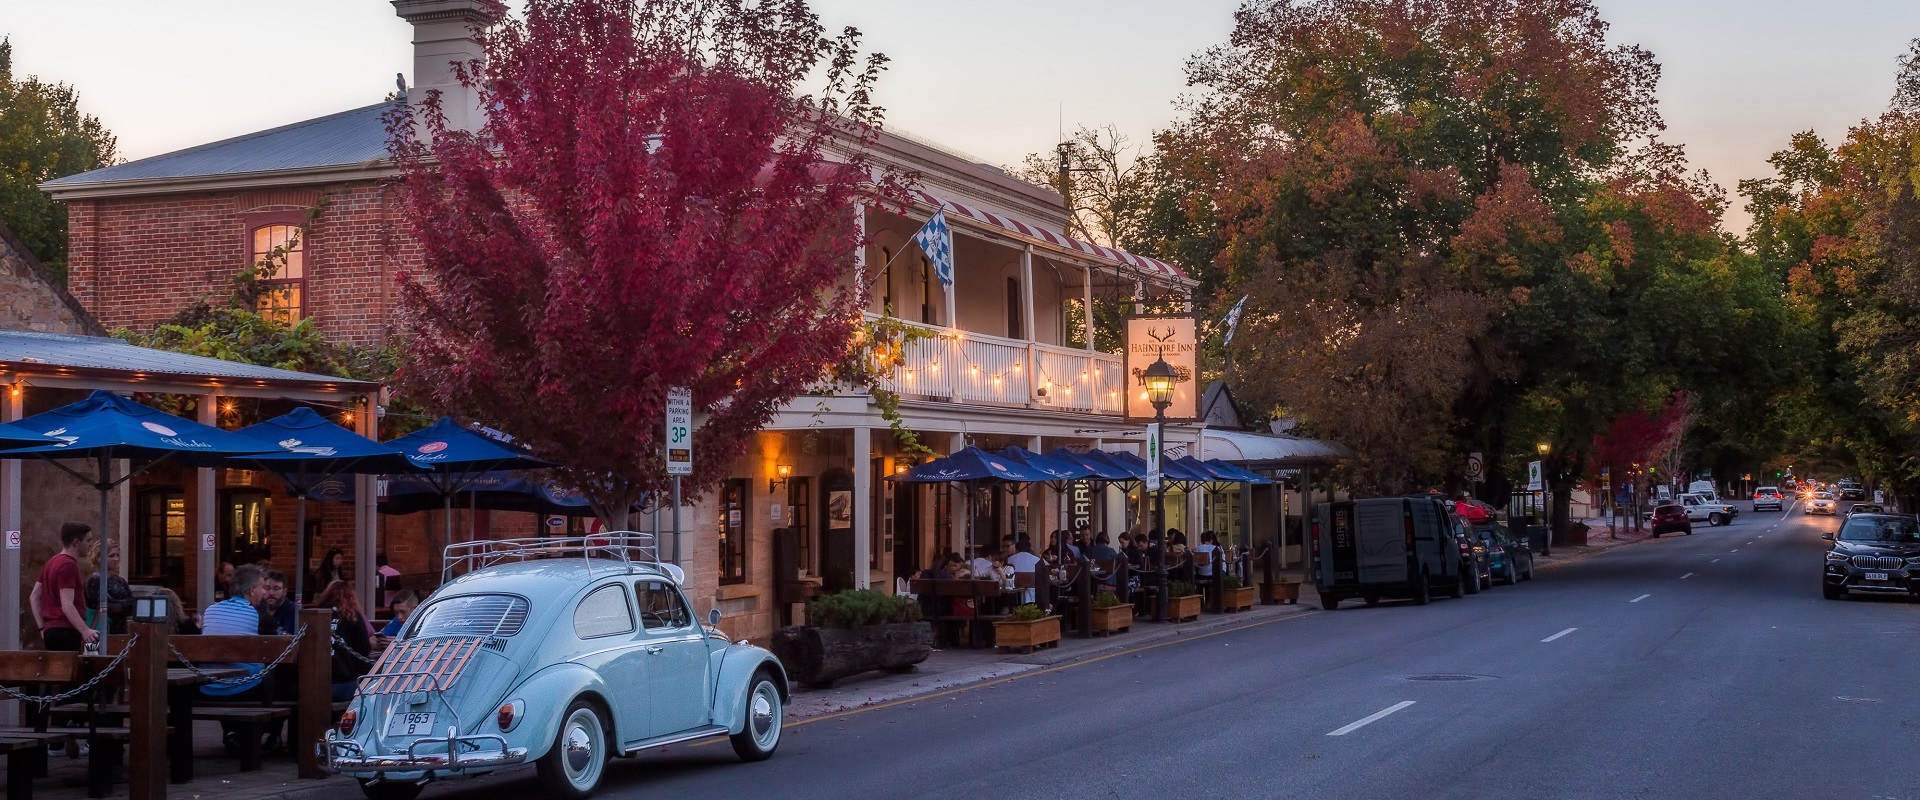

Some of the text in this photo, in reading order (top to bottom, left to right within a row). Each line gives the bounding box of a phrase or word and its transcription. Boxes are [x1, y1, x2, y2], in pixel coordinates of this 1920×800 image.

[1131, 343, 1193, 352] HAHNDORF INN
[668, 407, 689, 415] PARKING
[671, 426, 687, 443] 3P
[403, 714, 430, 724] 1963
[408, 724, 416, 734] B
